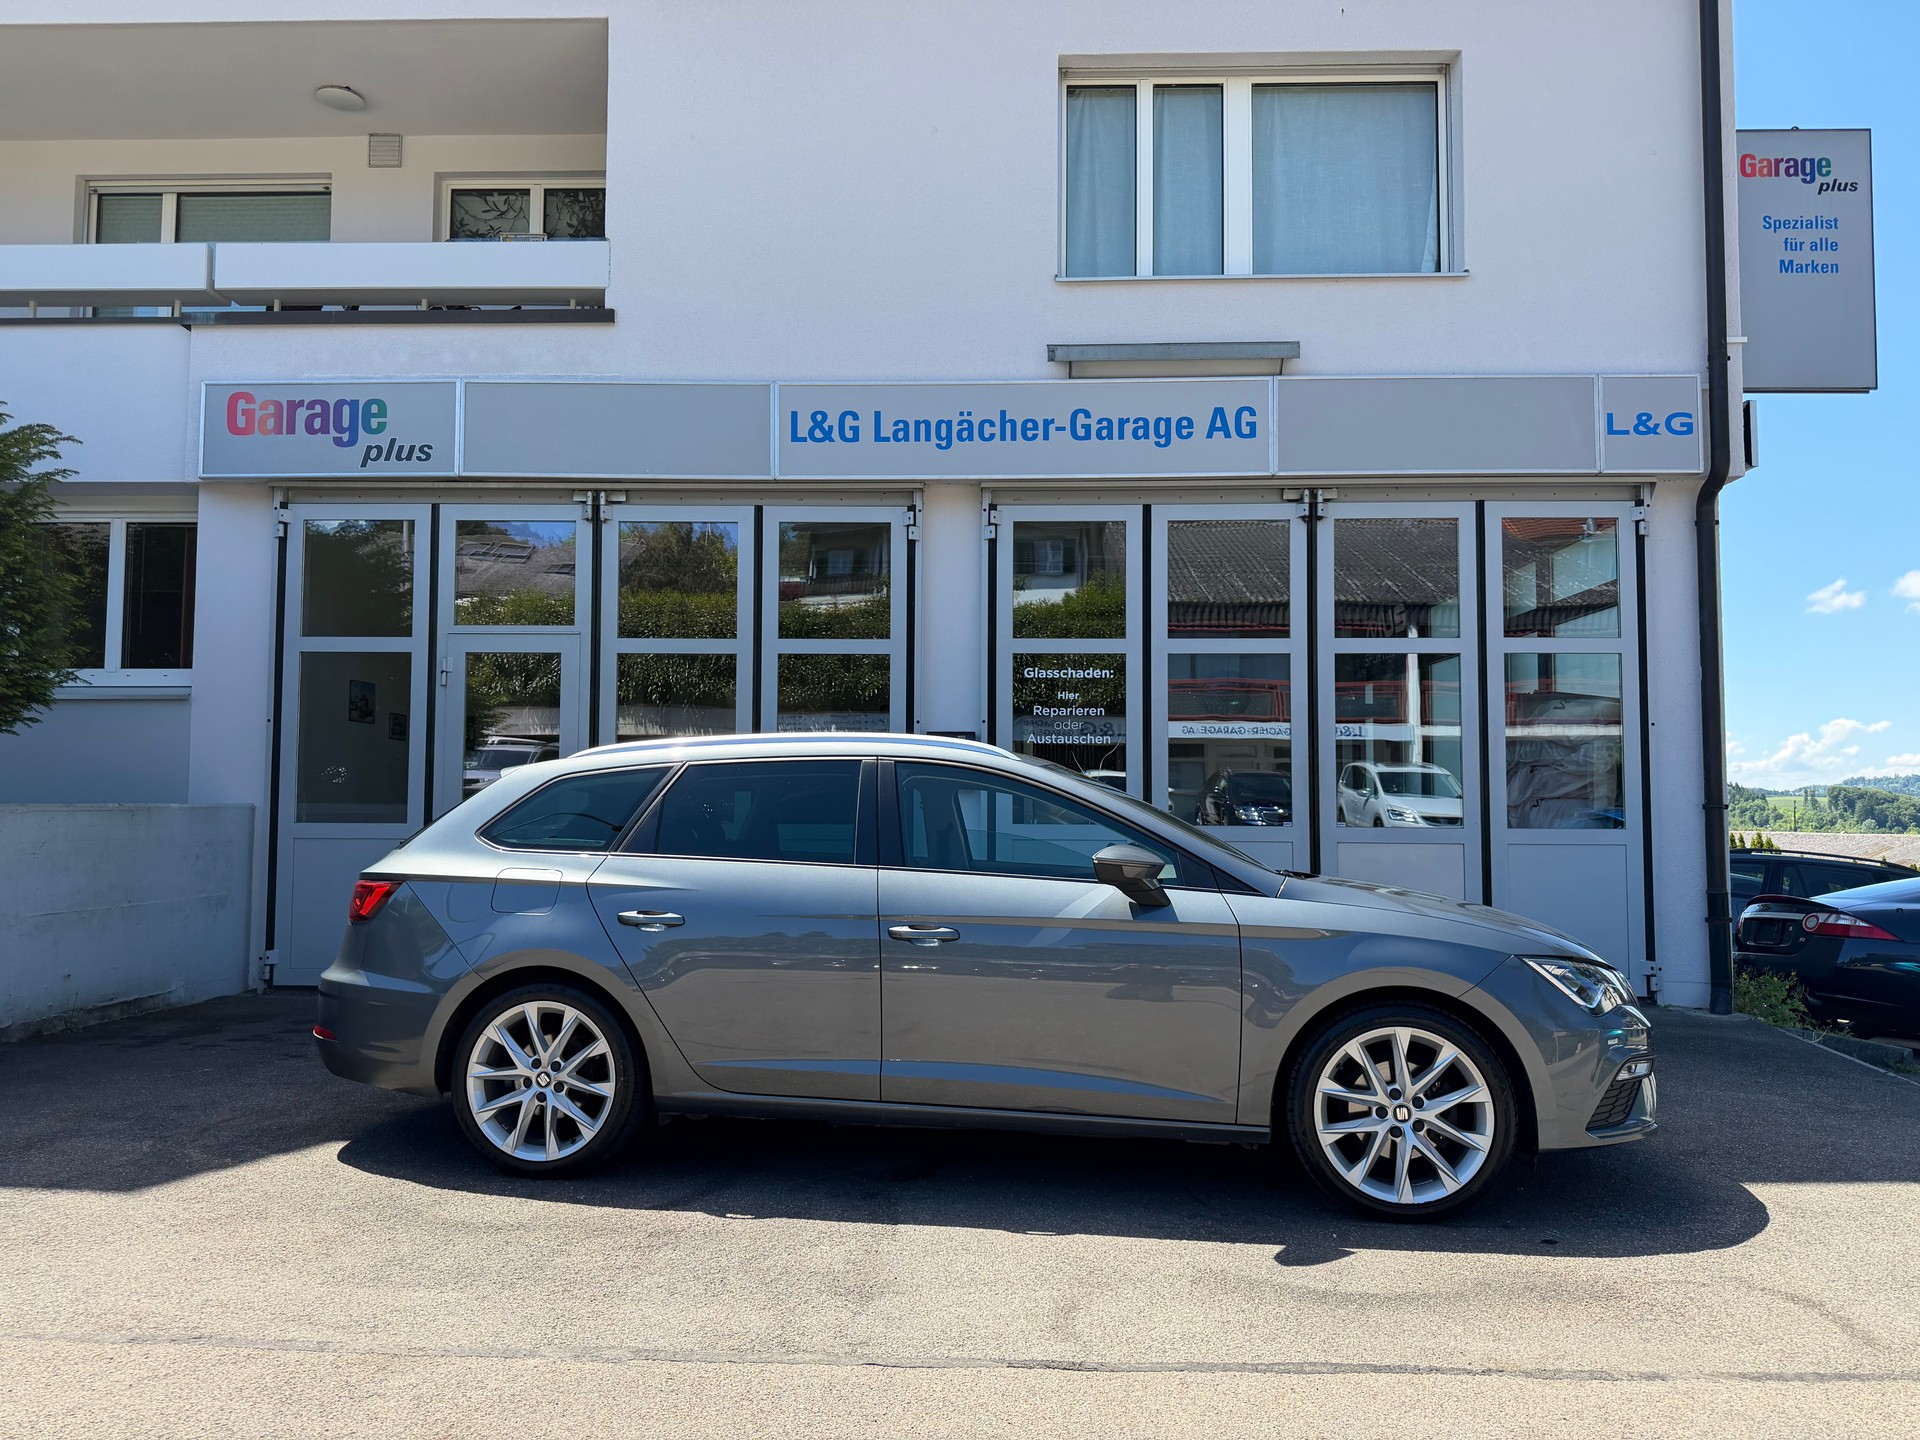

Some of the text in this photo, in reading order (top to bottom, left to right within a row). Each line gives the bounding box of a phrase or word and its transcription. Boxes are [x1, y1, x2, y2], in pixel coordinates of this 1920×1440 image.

[1740, 153, 1832, 185] Garage
[1817, 178, 1859, 195] plus
[1762, 215, 1839, 233] Spezialist
[1783, 237, 1839, 252] für alle
[1779, 259, 1839, 274] Marken
[226, 391, 388, 448] Garage
[1606, 412, 1694, 436] L&G
[790, 406, 1257, 450] L&G Langächer-Garage AG
[359, 437, 434, 468] plus
[1024, 667, 1114, 679] Glasschaden:
[1057, 691, 1080, 700] Hier
[1033, 705, 1105, 717] Reparieren
[1054, 719, 1083, 730] oder
[1027, 733, 1111, 744] Austauschen
